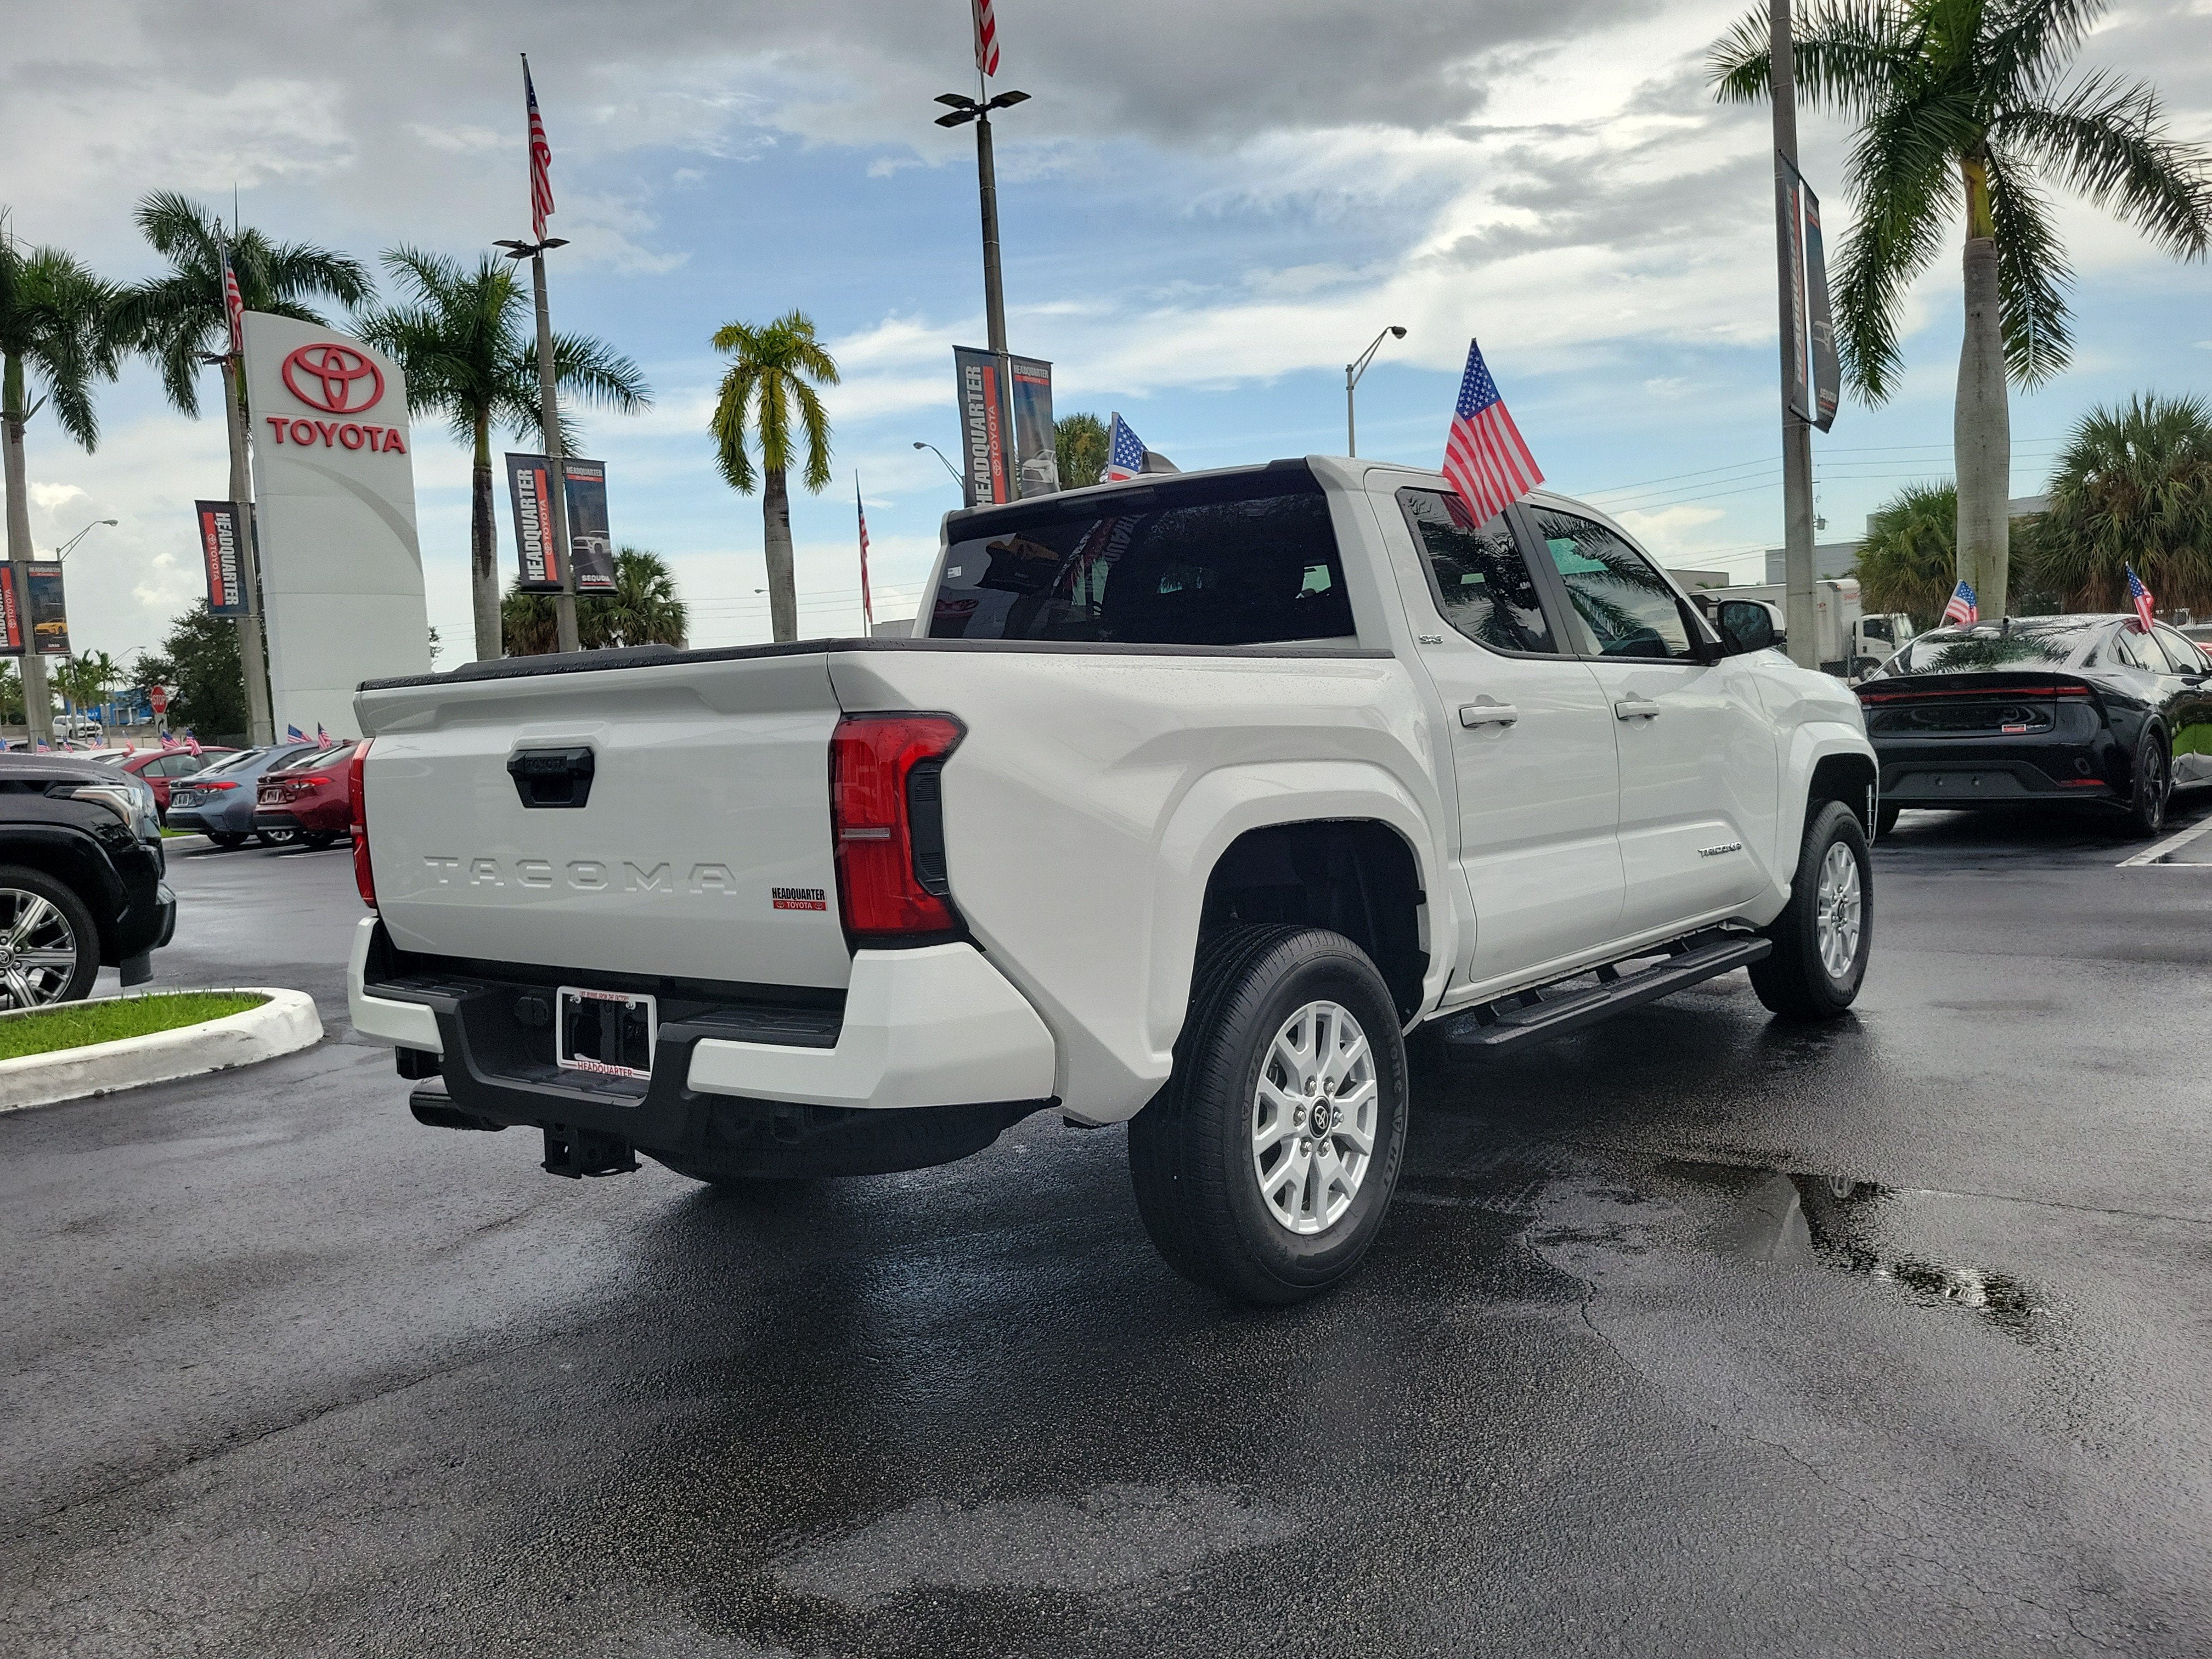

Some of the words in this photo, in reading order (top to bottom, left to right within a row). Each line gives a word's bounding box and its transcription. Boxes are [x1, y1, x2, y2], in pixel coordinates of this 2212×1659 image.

[267, 417, 407, 454] TOYOTA
[966, 365, 993, 506] HEADQUARTER
[988, 405, 1000, 459] TOYOTA
[517, 469, 546, 580] HEADQUARTER
[539, 500, 552, 539] TOYOTA
[210, 546, 219, 581] TOYOTA
[215, 512, 239, 606] HEADQUARTER
[5, 589, 15, 619] TOYOTA
[153, 694, 165, 706] STOP
[526, 758, 567, 771] TOYOTA
[424, 856, 737, 895] TACOMA
[772, 887, 825, 900] HEADQUARTER
[577, 1062, 633, 1077] HEADQUARTER
